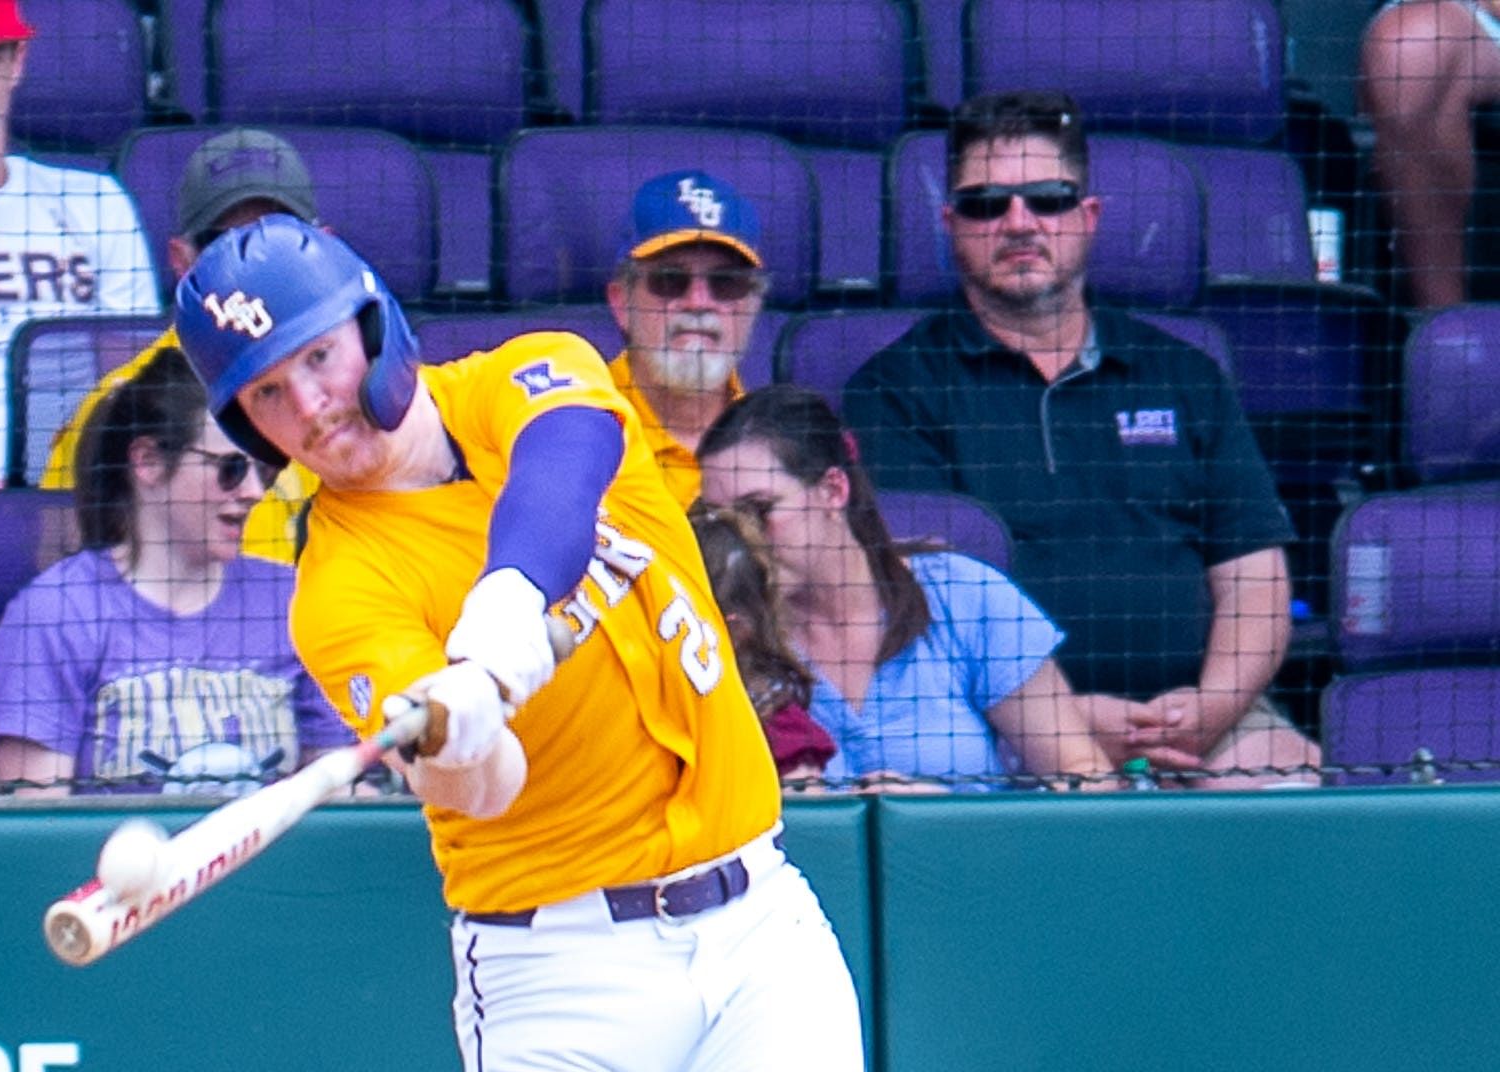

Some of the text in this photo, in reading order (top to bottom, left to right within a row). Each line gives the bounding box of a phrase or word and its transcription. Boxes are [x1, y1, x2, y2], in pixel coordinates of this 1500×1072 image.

[678, 178, 722, 227] LSU
[203, 290, 273, 338] LSU
[657, 574, 724, 693] 2
